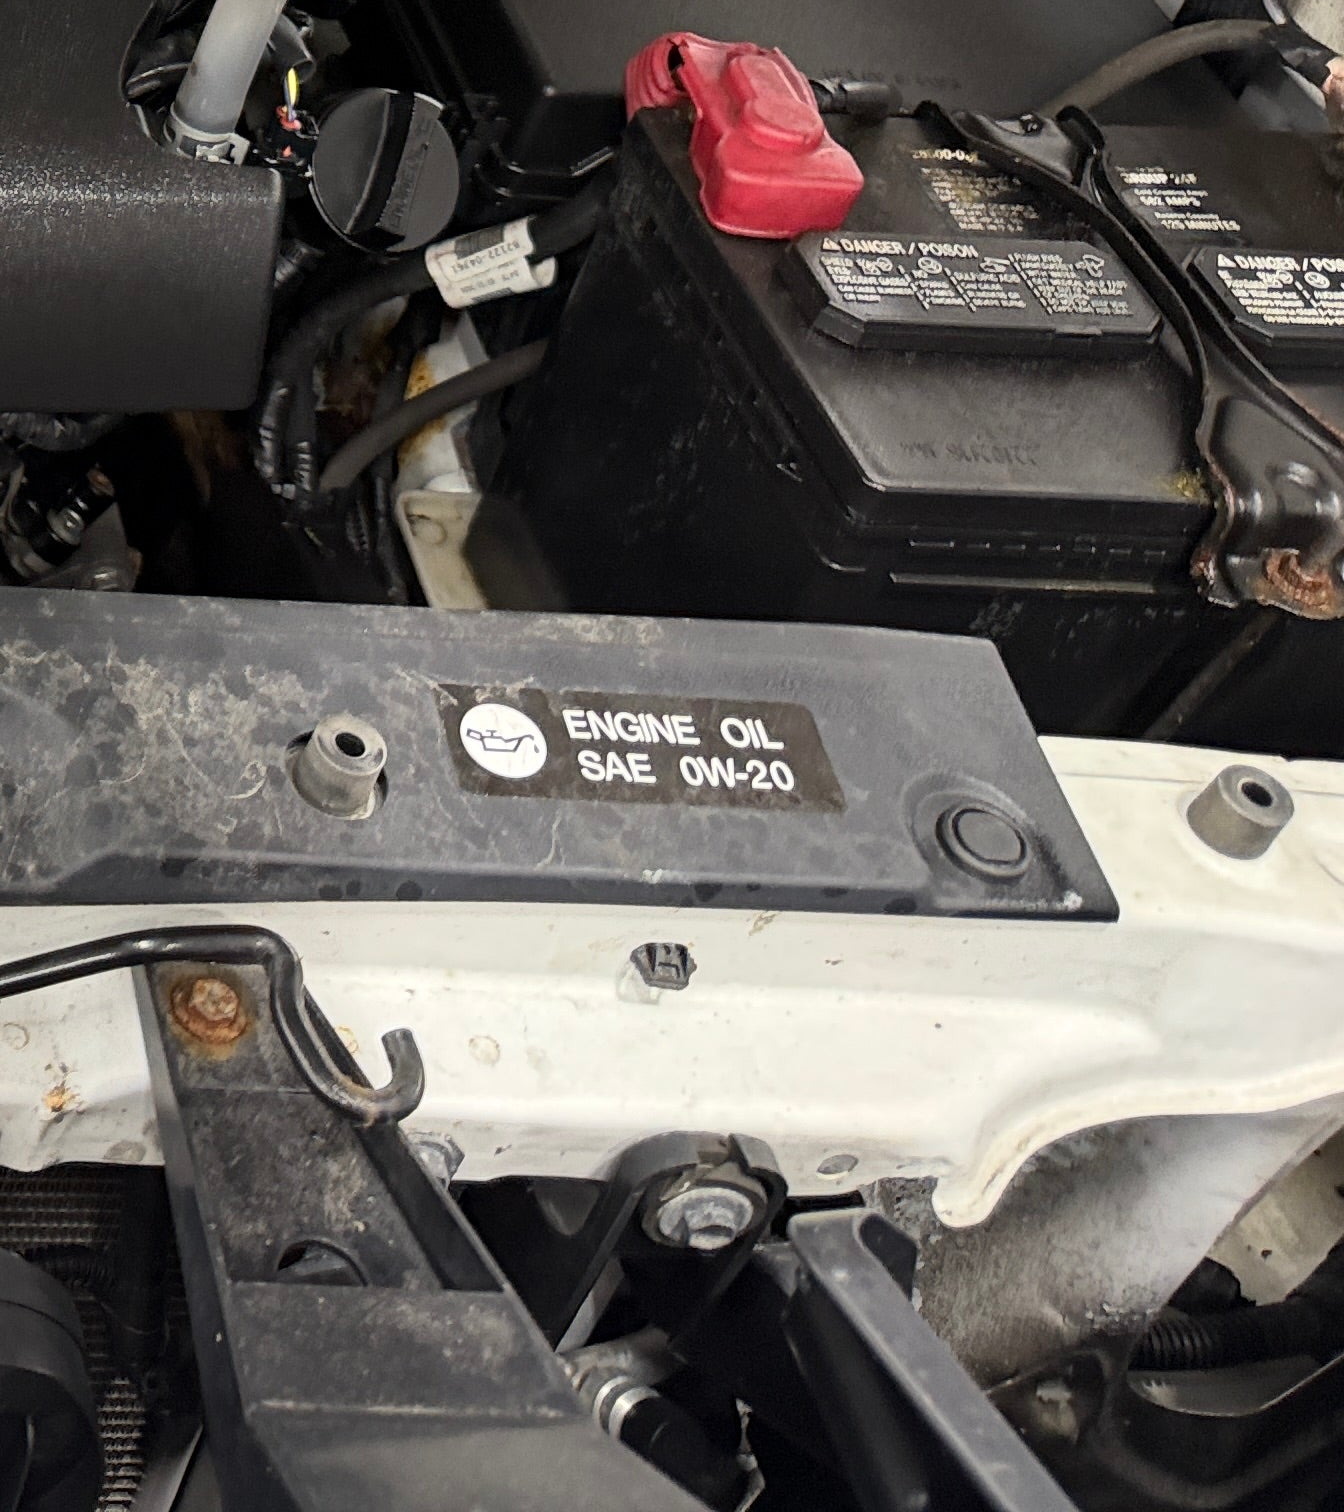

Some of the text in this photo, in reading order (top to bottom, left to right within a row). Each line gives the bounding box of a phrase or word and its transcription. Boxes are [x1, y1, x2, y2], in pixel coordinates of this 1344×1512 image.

[839, 238, 906, 255] DANGER
[917, 242, 979, 259] POISON
[1233, 254, 1301, 272] DANGER
[562, 708, 785, 751] ENGINE OIL
[577, 752, 796, 793] SAE 0W-20
